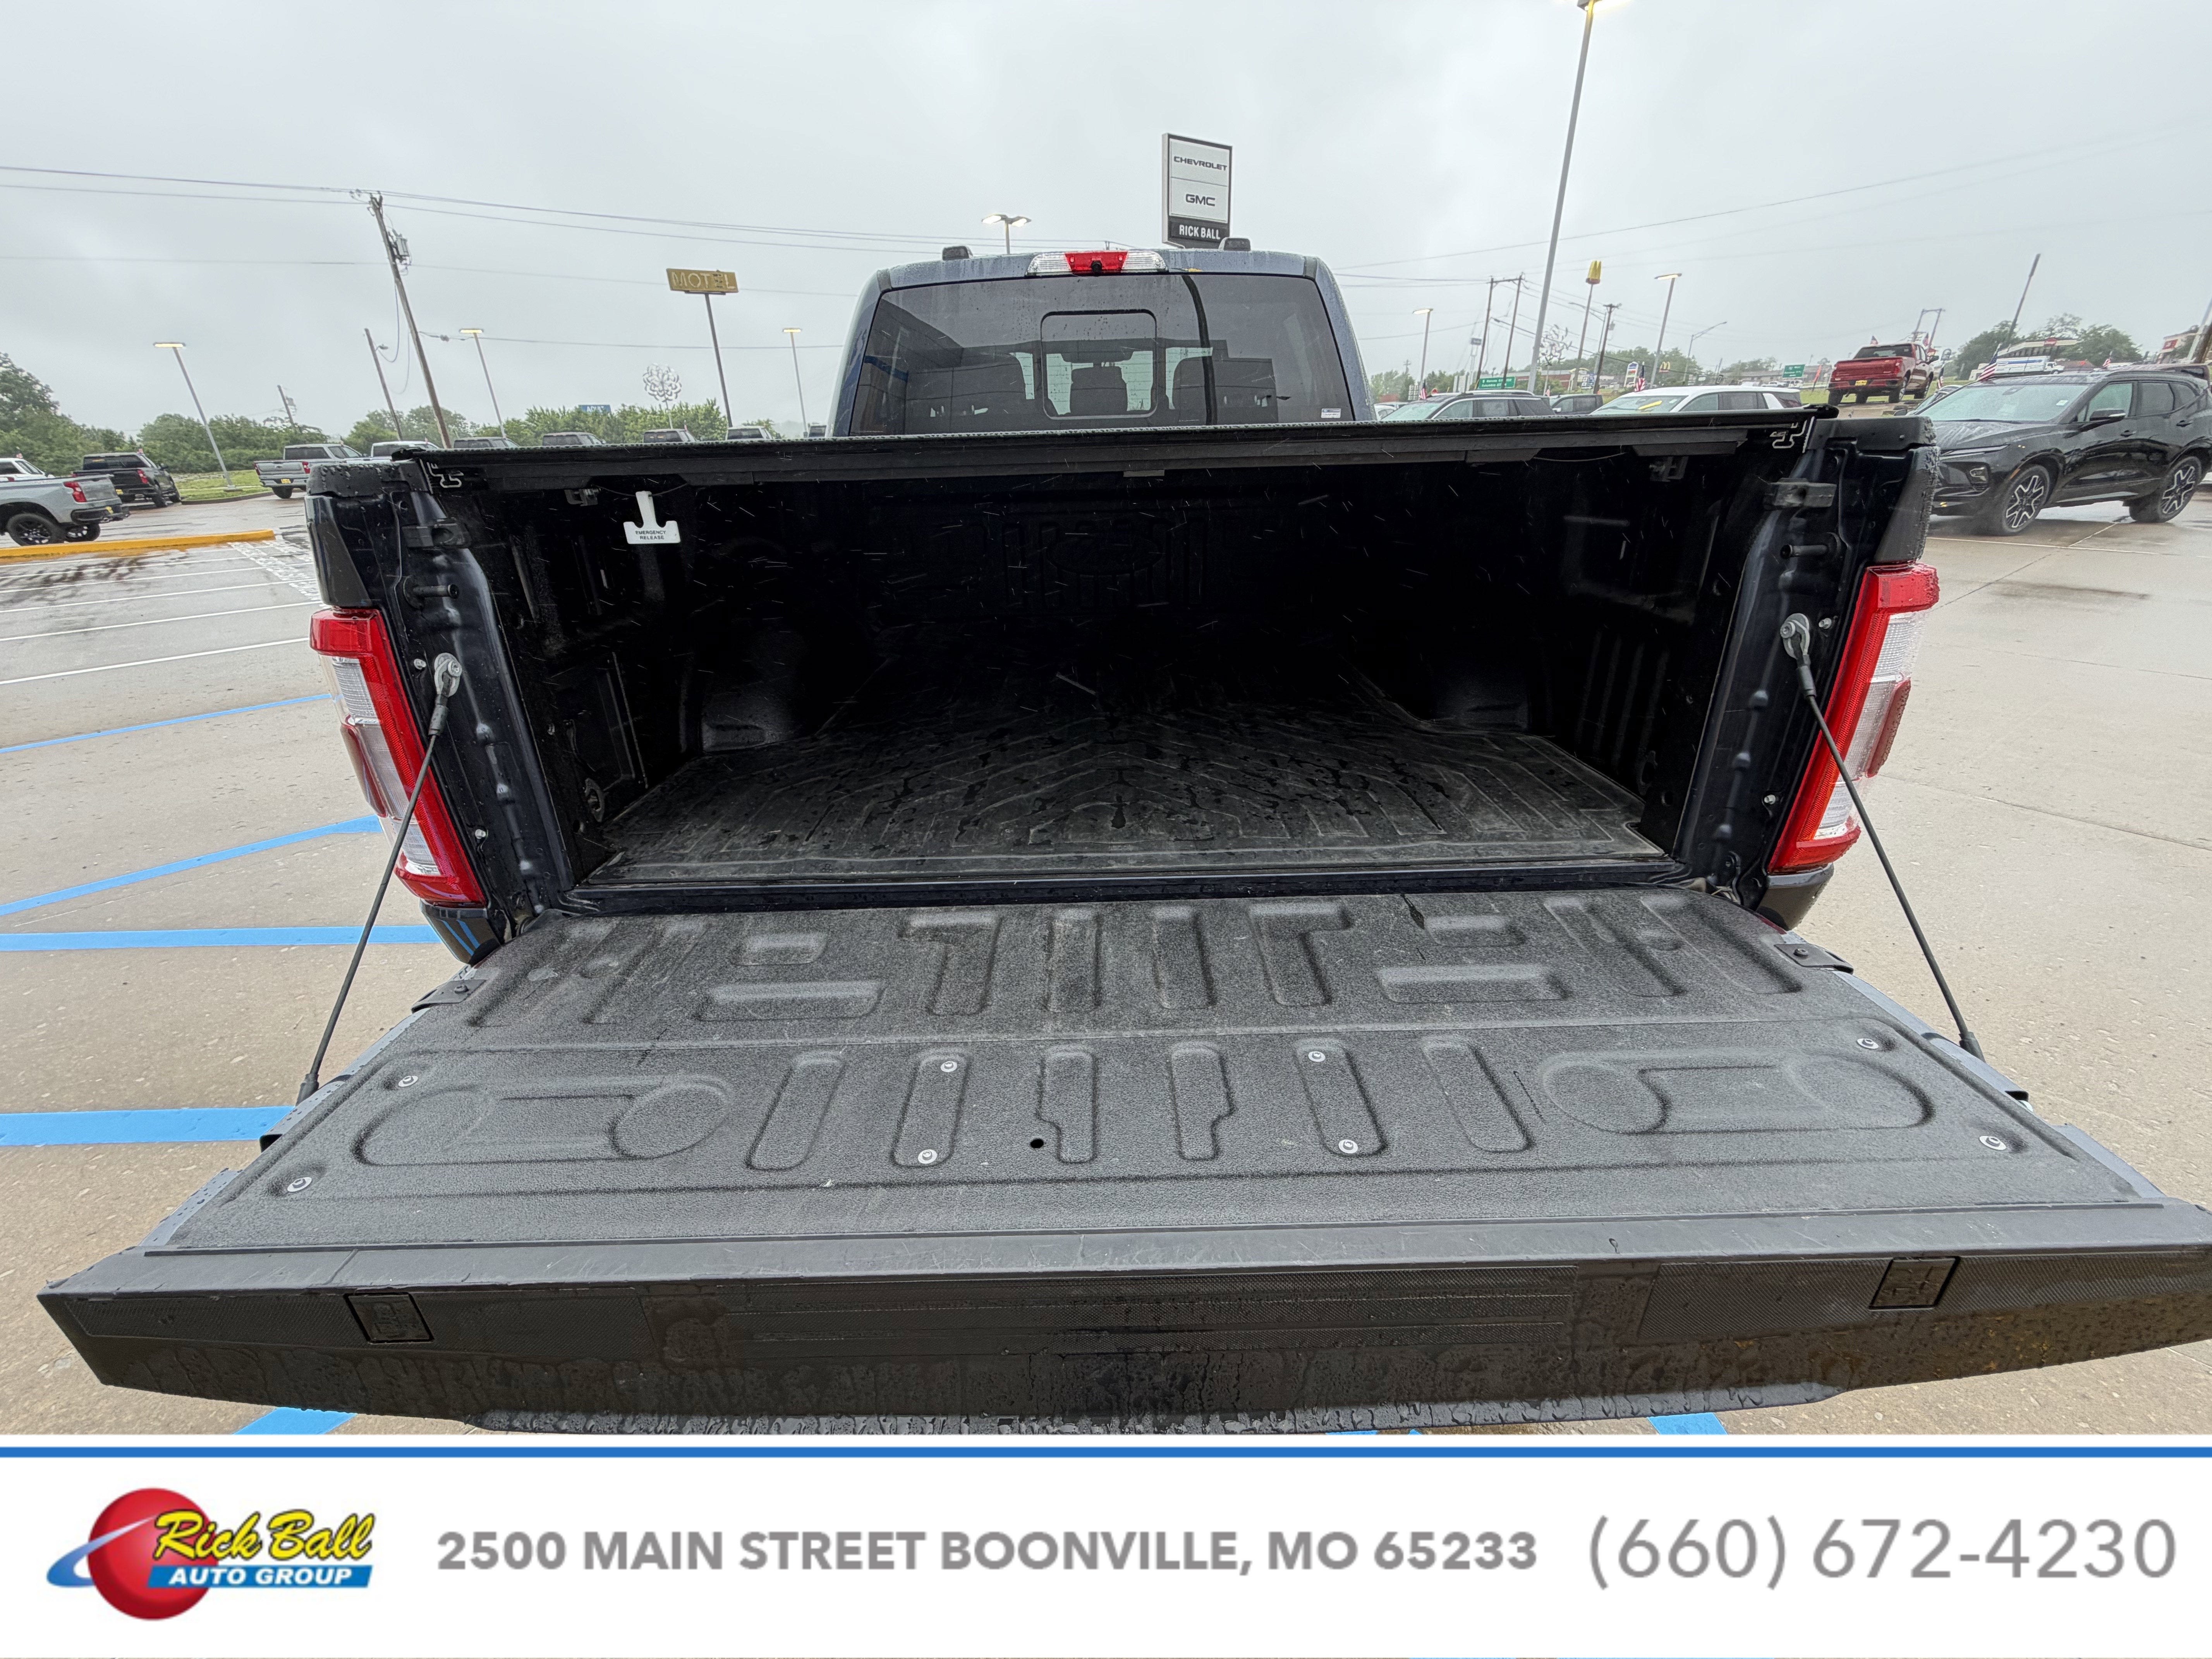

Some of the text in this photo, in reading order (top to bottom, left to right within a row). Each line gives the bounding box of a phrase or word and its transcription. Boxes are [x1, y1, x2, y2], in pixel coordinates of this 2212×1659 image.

[1173, 156, 1227, 171] CHEVROLET
[1185, 194, 1216, 206] GMC
[1179, 224, 1221, 240] RICK BALL
[671, 271, 735, 289] MOTEL
